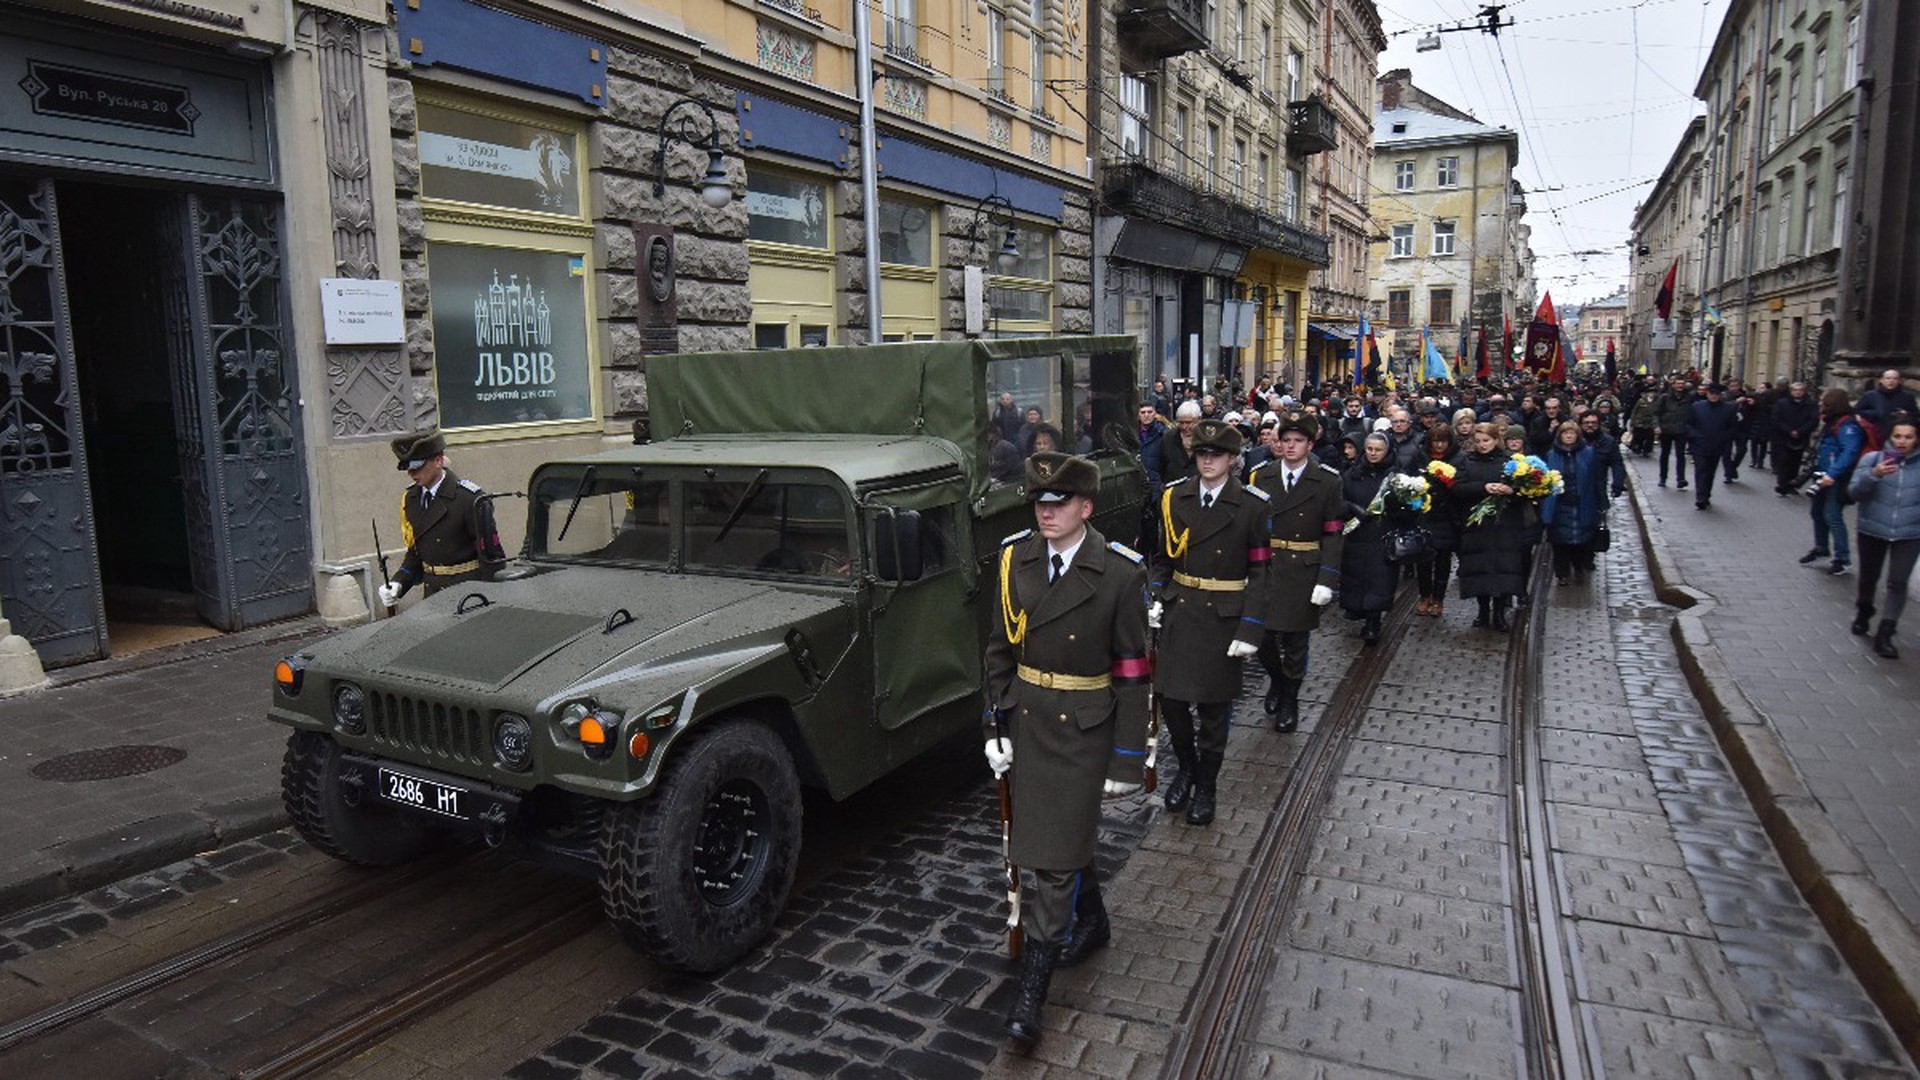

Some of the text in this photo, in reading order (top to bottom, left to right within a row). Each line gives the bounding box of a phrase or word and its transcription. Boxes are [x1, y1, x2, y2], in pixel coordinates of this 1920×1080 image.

[58, 84, 168, 113] Вул. Руська 20
[474, 352, 556, 387] ЛЬВІВ
[389, 776, 424, 804] 2686
